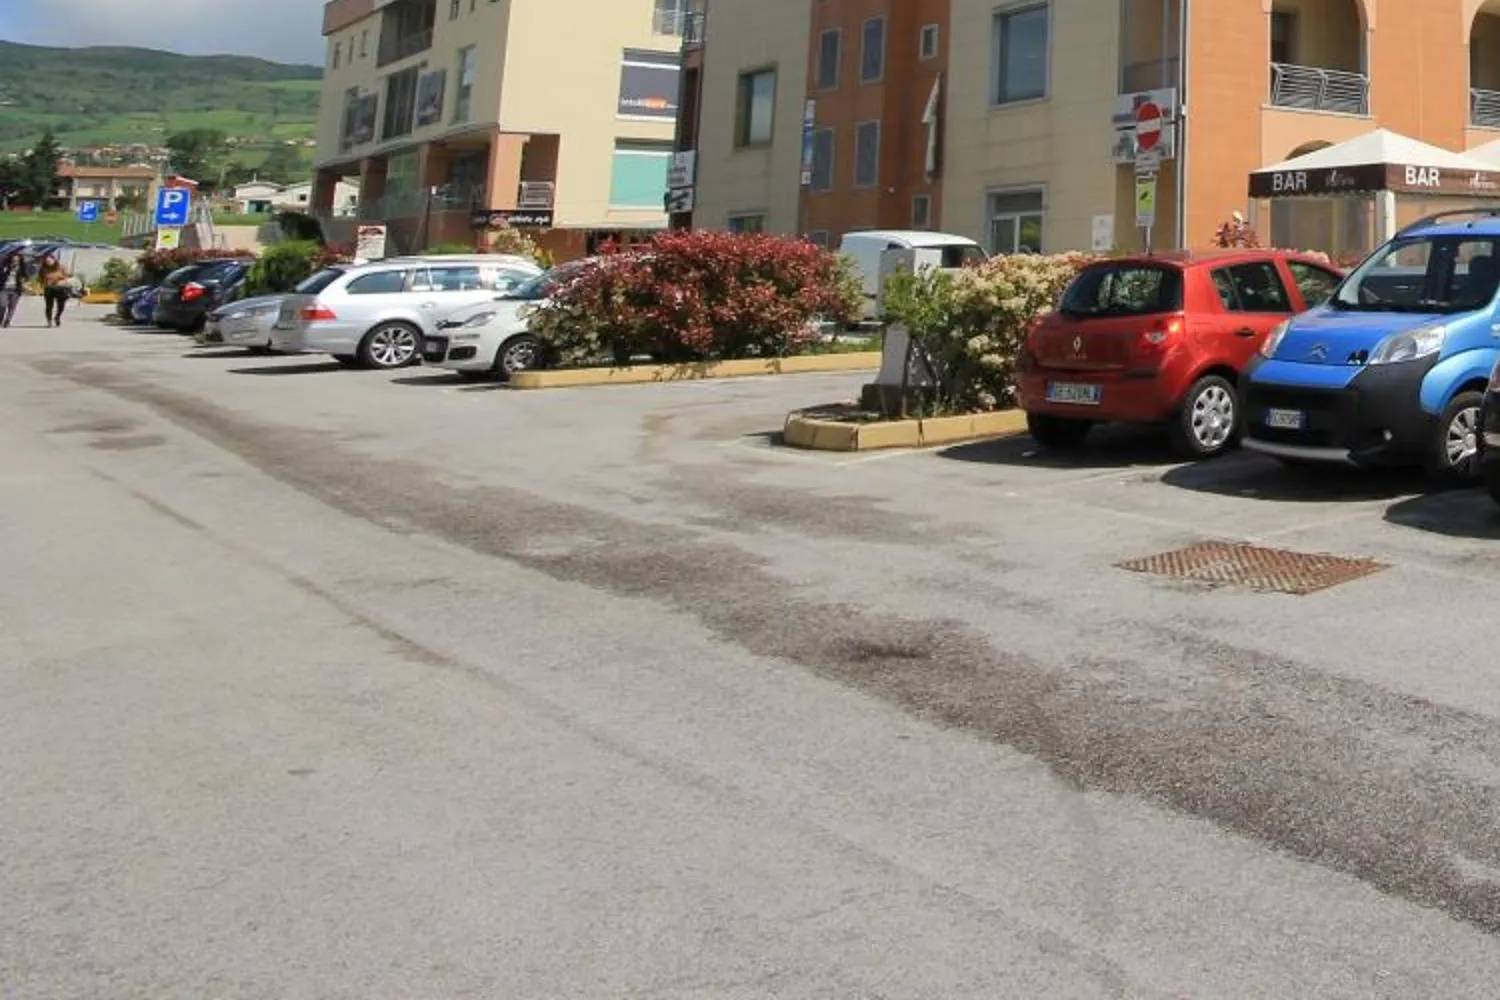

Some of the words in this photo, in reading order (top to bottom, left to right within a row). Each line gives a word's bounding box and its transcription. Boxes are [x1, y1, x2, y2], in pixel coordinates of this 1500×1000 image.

[1273, 171, 1308, 192] BAR
[1405, 165, 1440, 187] BAR
[83, 201, 95, 213] P
[164, 191, 184, 209] P
